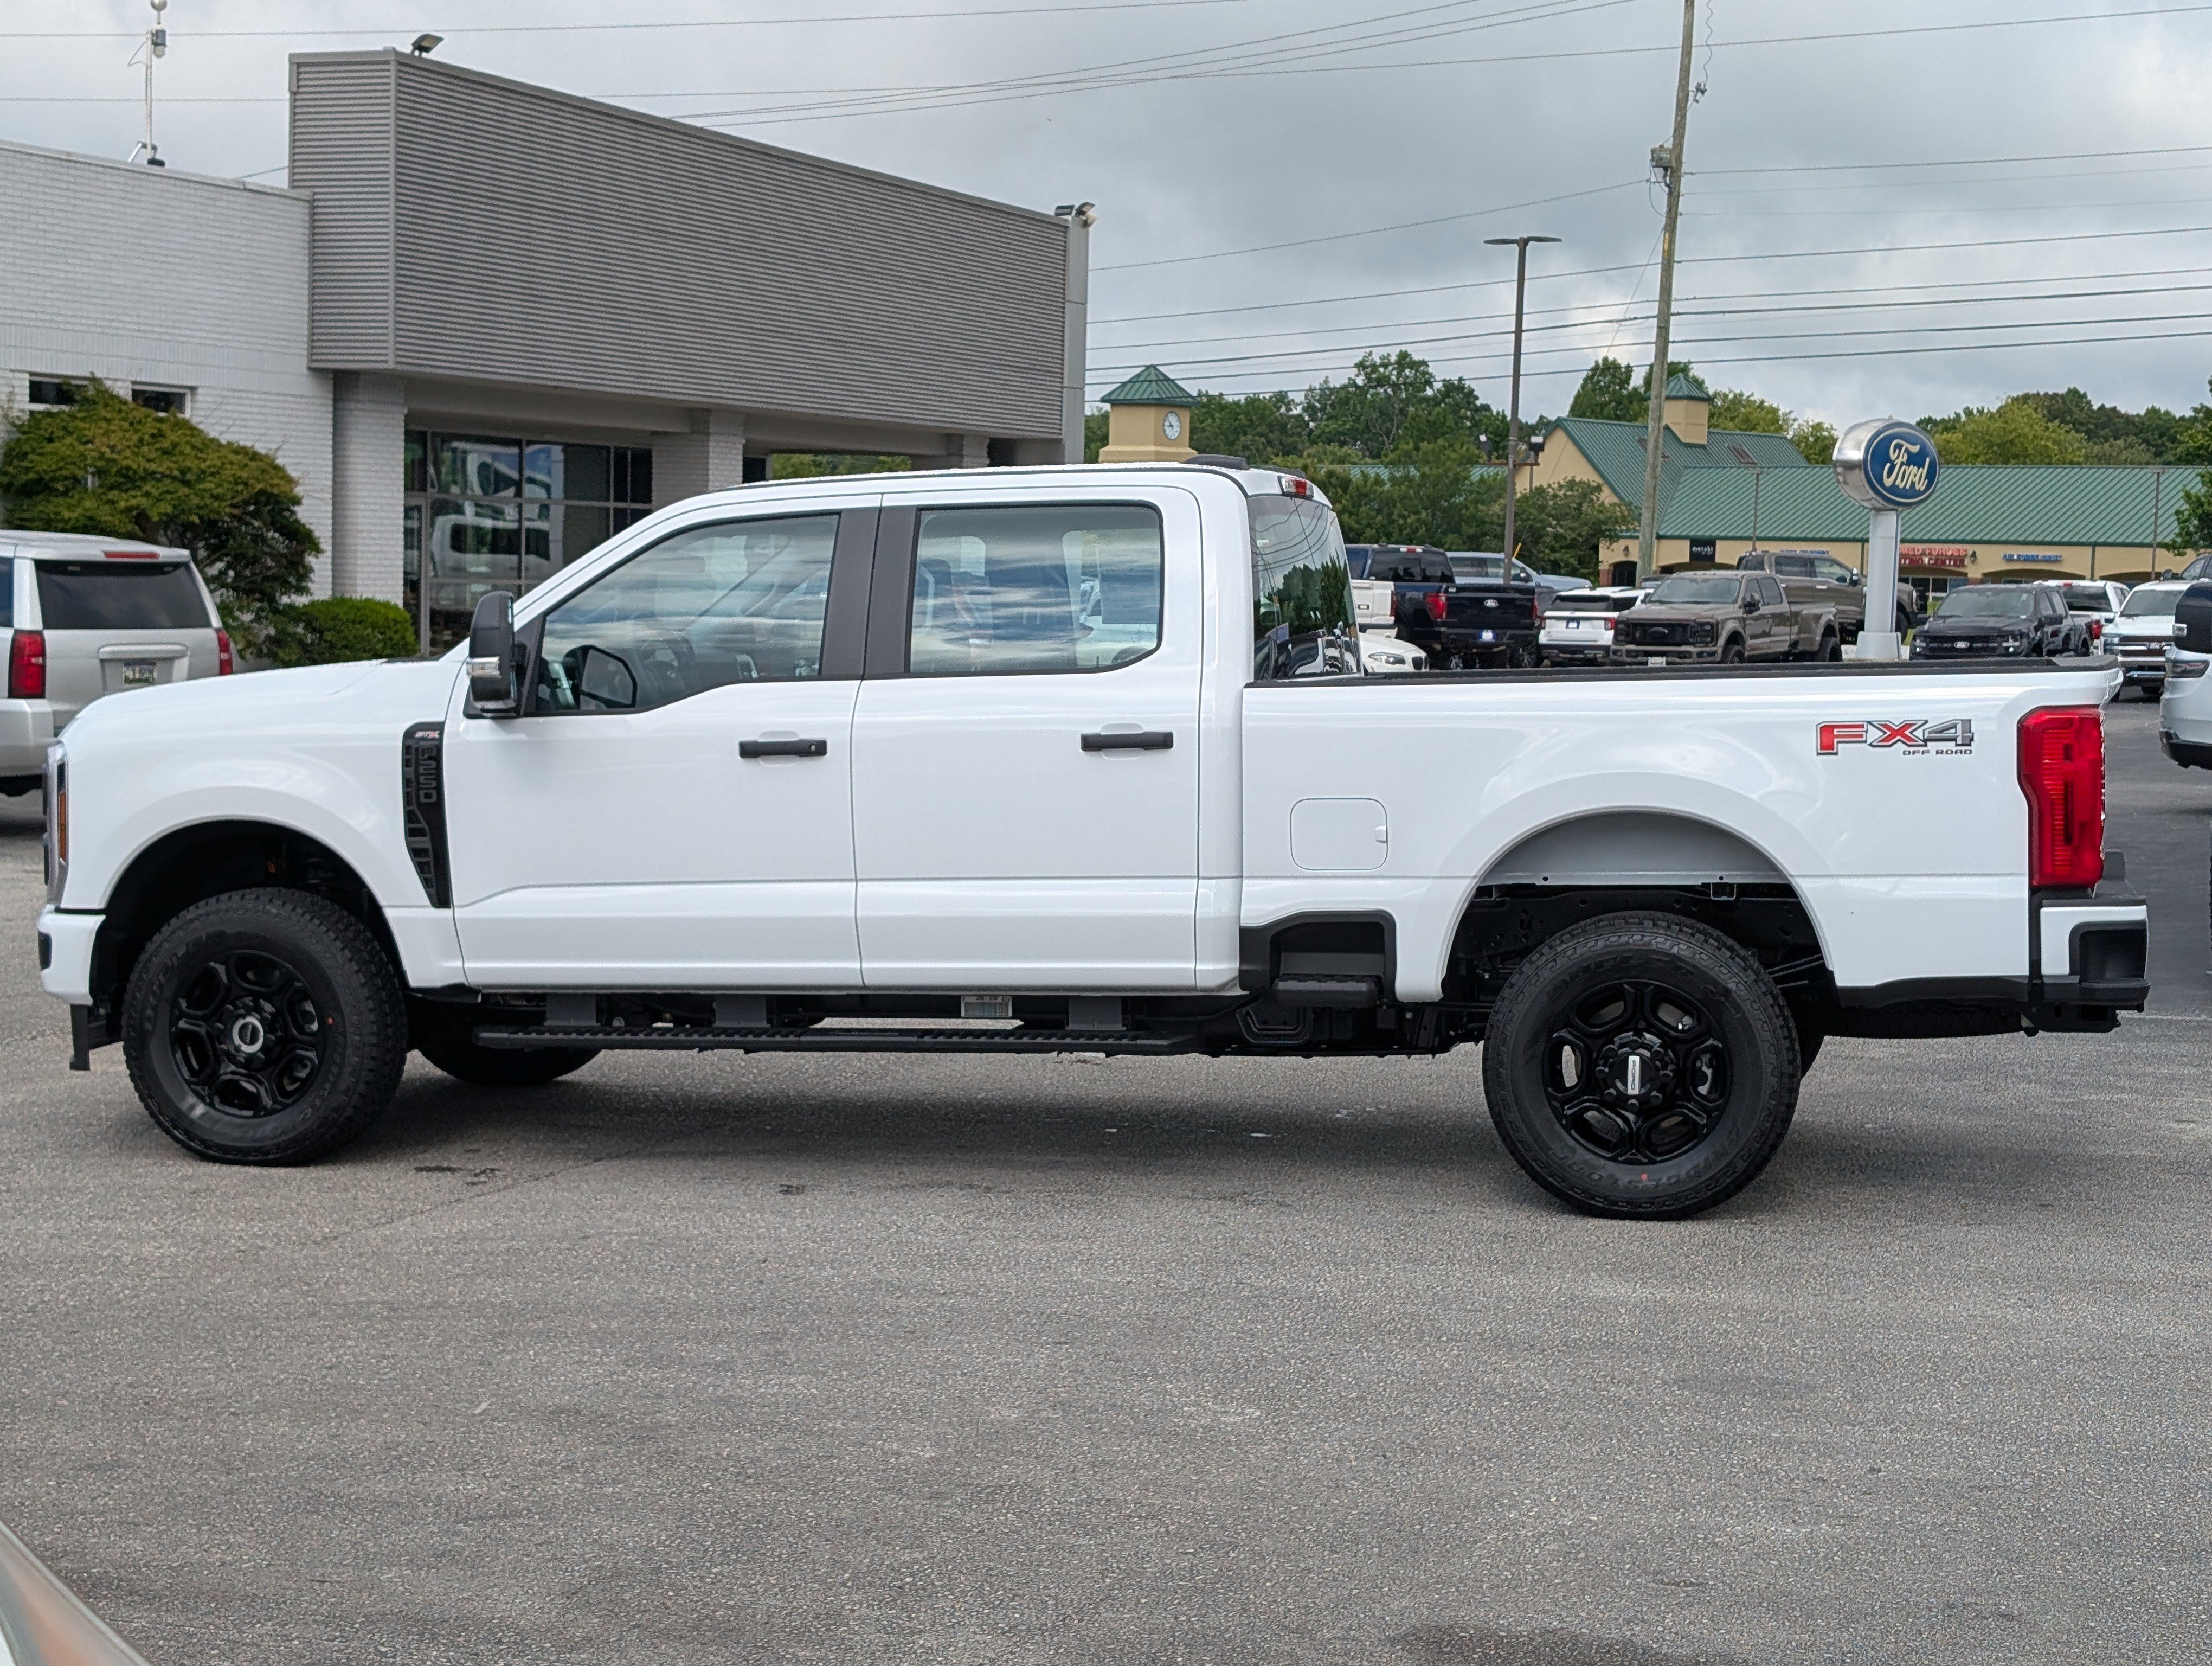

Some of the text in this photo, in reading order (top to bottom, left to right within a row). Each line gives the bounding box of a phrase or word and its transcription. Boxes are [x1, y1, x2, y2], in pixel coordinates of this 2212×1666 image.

[1883, 439, 1930, 491] Ford
[1900, 547, 1923, 555] MED
[1816, 719, 1974, 755] FX4
